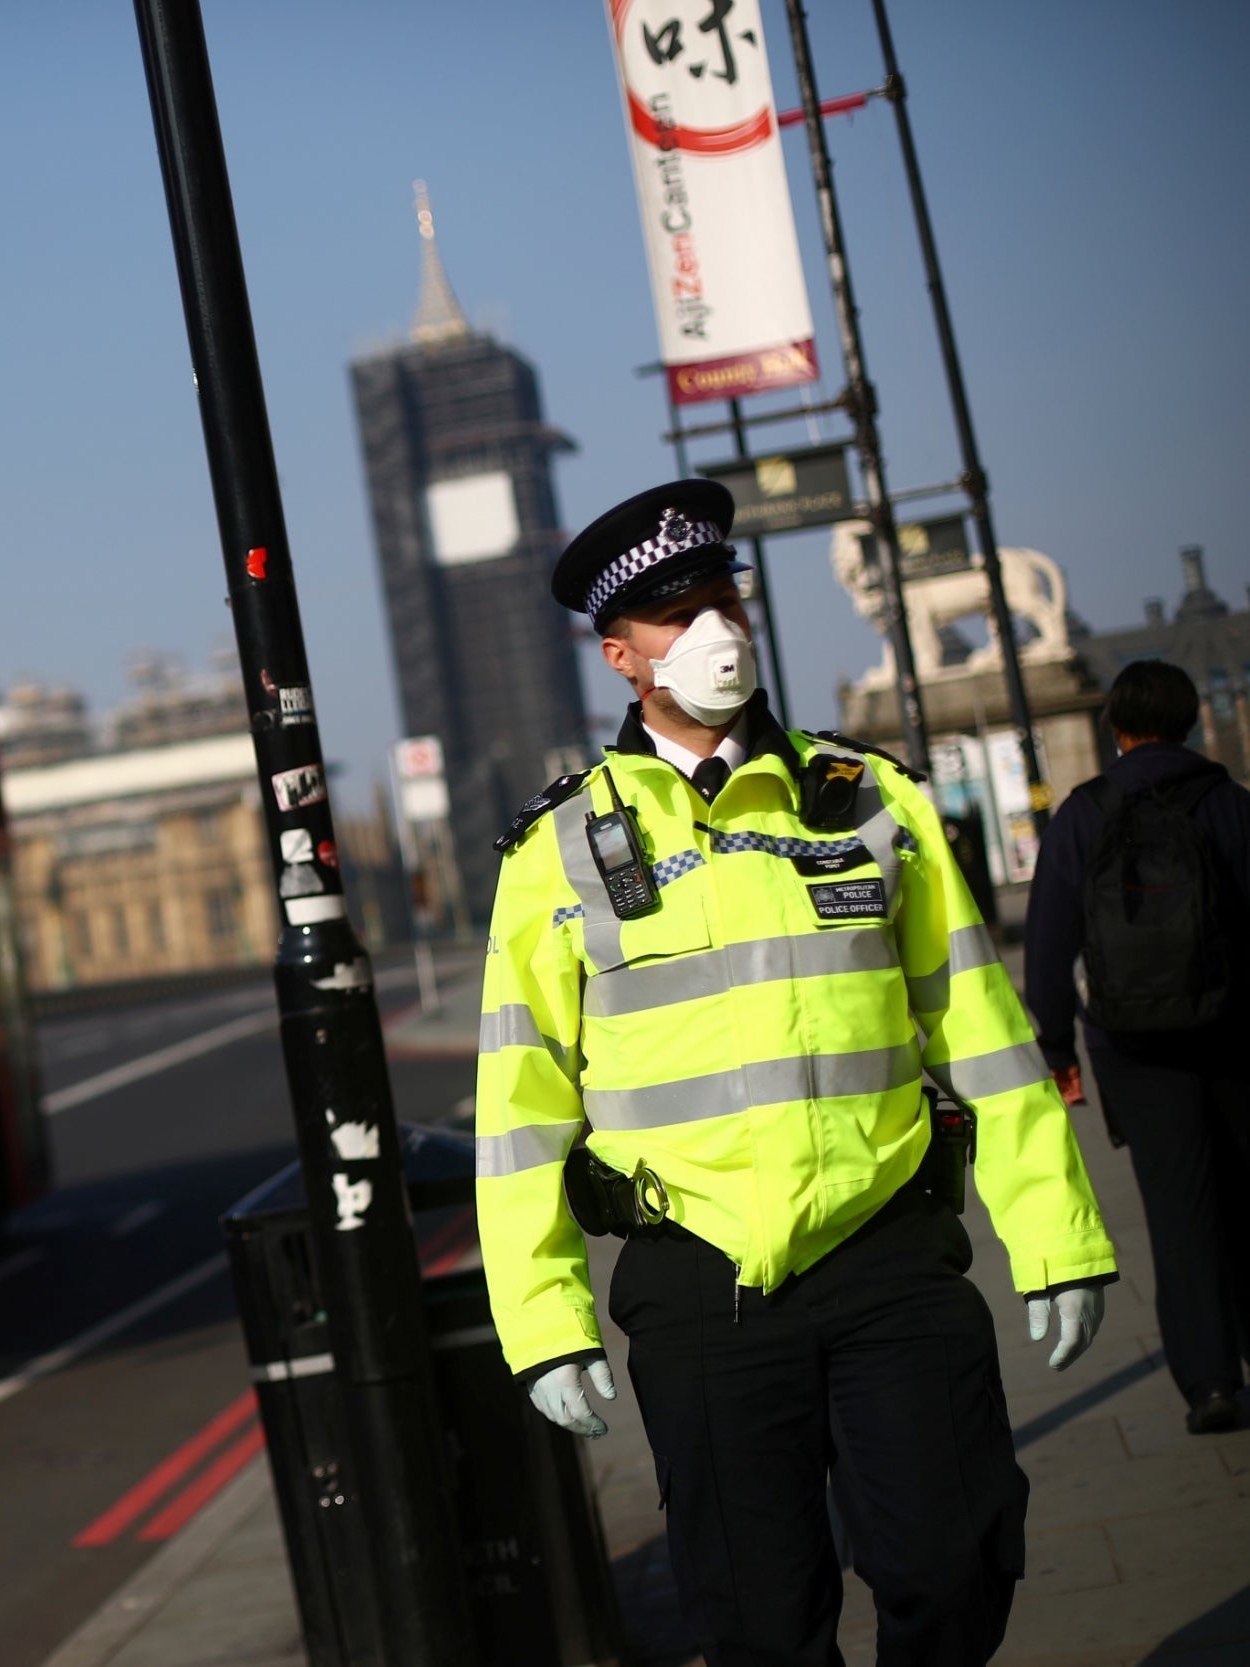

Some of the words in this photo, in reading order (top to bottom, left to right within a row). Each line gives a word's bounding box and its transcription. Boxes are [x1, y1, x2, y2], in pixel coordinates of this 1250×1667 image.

[720, 664, 735, 673] 3M
[835, 885, 876, 893] METROPOLITAN
[843, 891, 872, 899] POLICE
[819, 905, 849, 914] POLICE
[850, 904, 883, 913] OFFICER
